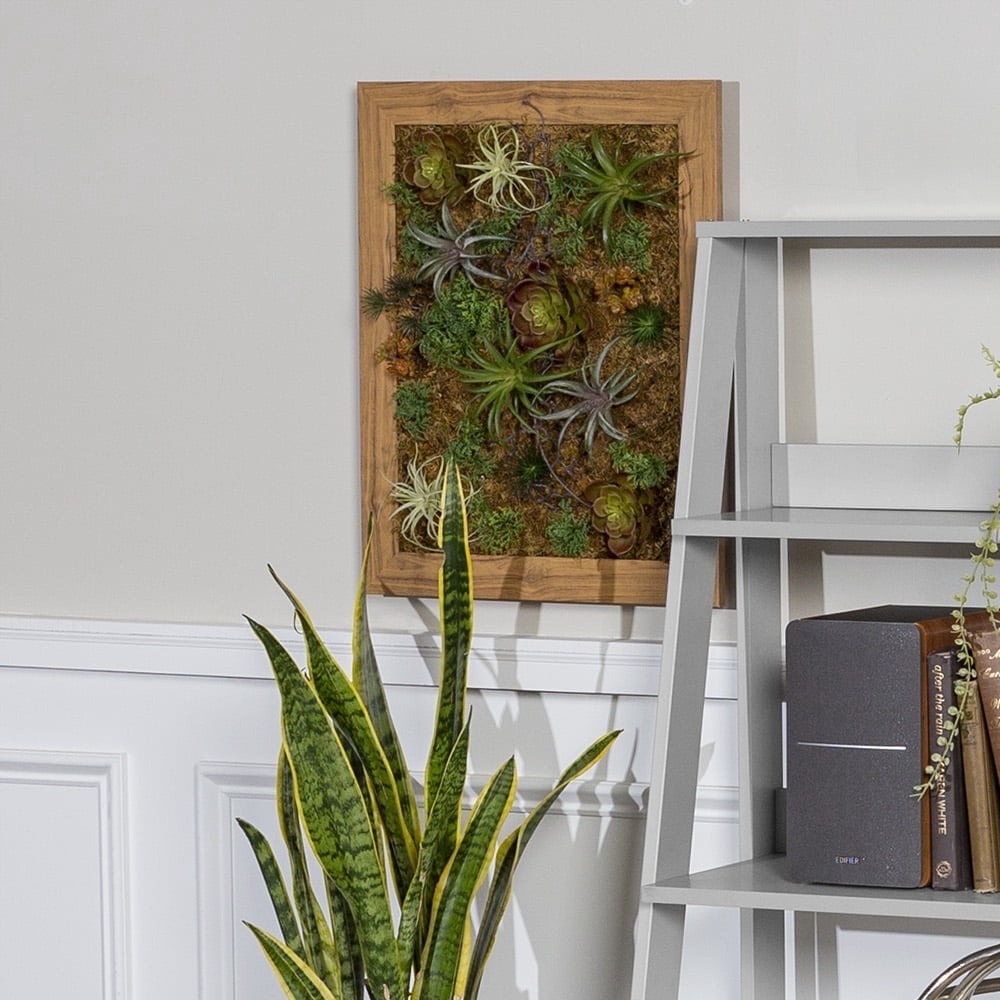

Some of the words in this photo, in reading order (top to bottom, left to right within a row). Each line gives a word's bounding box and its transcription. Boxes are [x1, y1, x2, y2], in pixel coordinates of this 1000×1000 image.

[932, 664, 945, 692] after
[935, 693, 945, 711] the
[935, 713, 945, 736] rain
[938, 800, 947, 836] WHITE
